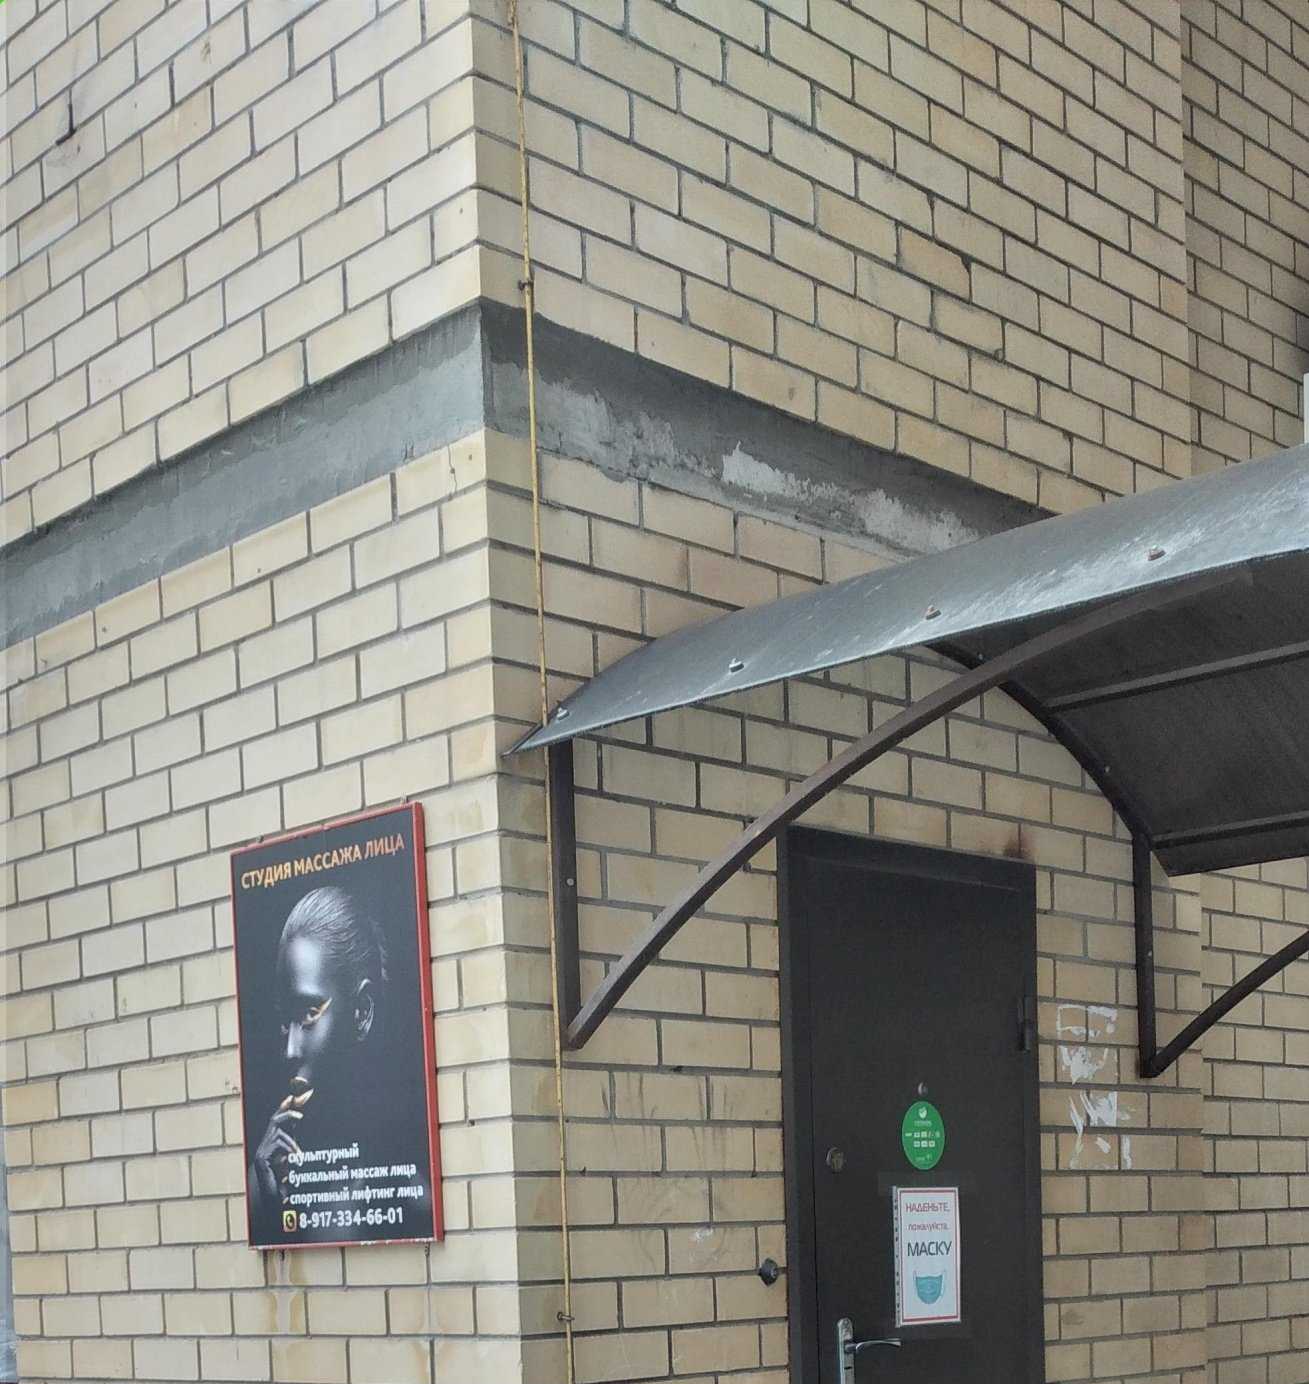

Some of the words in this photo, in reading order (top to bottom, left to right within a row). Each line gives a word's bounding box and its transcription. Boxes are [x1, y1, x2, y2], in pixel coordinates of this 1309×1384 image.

[241, 862, 292, 889] СТУДИЯ
[294, 844, 362, 876] МАССАЖА
[364, 833, 405, 859] ЛИЦА
[289, 1165, 349, 1187] буккальный
[350, 1166, 388, 1179] массаж
[390, 1163, 416, 1178] лица
[290, 1186, 350, 1207] спортивный
[351, 1185, 396, 1204] лифтинг
[397, 1185, 424, 1199] лица
[299, 1206, 404, 1229] 8-917-334-66-01
[907, 1240, 952, 1257] МАСКУ
